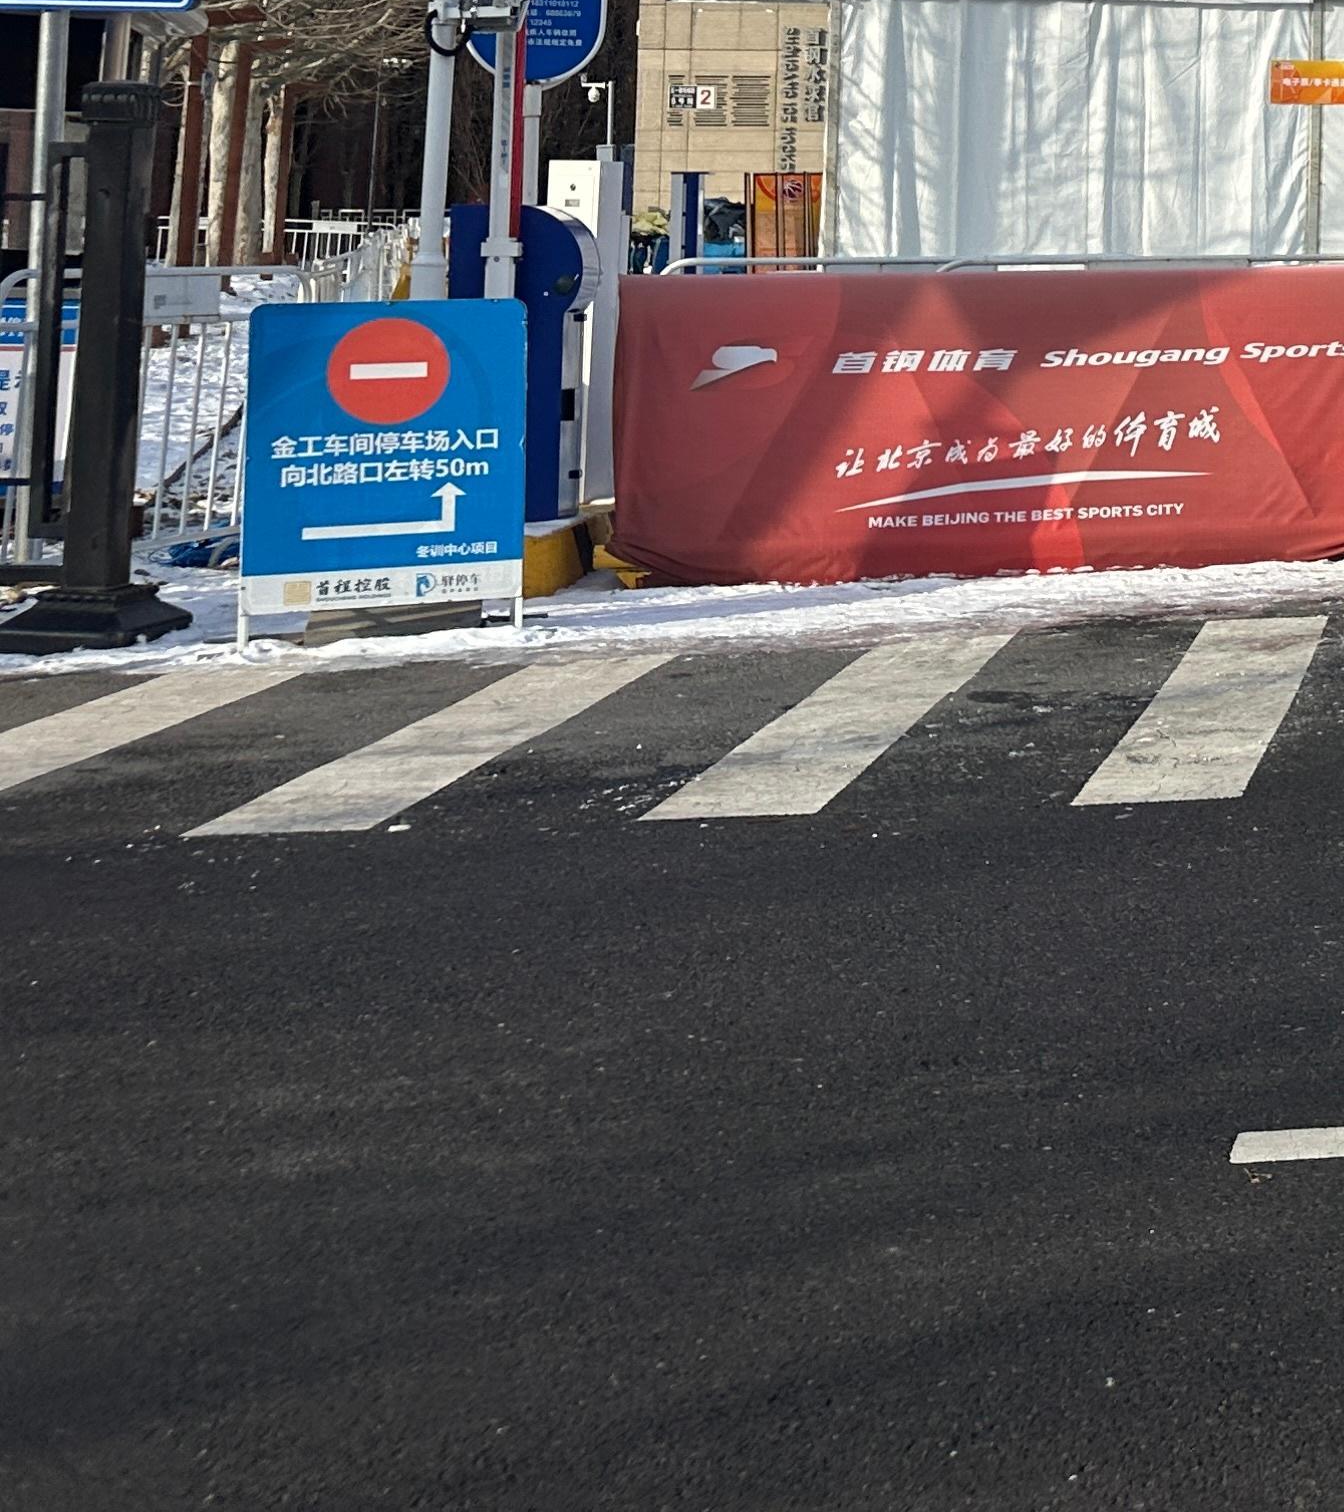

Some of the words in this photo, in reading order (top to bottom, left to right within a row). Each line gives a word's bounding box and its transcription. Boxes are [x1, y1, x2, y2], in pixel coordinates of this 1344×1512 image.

[699, 89, 712, 105] 2
[832, 348, 1018, 374] 首钢体育
[1040, 346, 1230, 368] Shougang
[271, 428, 499, 460] 金工车间停车场入口
[835, 405, 1221, 478] 让北京成为最好的体育城
[280, 458, 490, 488] 向北路口左转50m
[868, 514, 918, 529] MAKE
[922, 512, 990, 527] BEIJING
[993, 510, 1026, 524] THE
[1031, 508, 1073, 522] BEST
[1078, 504, 1144, 519] SPORTS
[1147, 502, 1185, 516] CITY
[416, 541, 498, 558] 冬训中心项目
